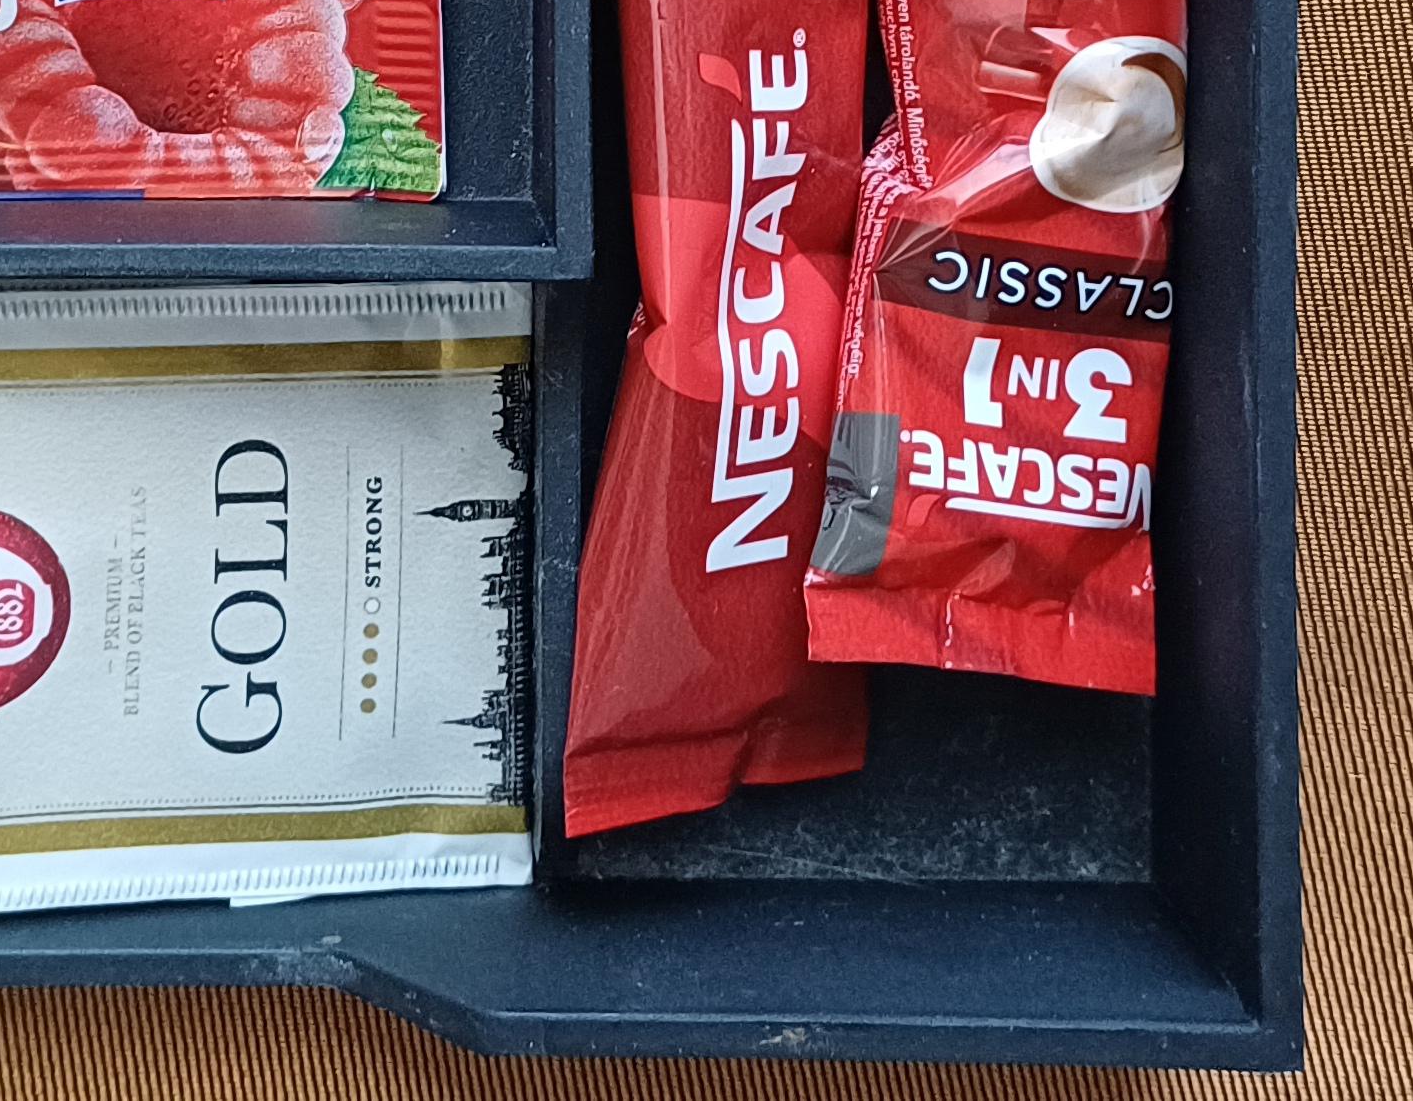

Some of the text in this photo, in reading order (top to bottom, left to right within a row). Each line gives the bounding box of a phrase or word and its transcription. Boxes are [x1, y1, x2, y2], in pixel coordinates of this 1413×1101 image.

[927, 250, 1174, 320] CLASSIC
[364, 475, 383, 588] STRONG
[103, 556, 124, 652] PREMIUM
[126, 619, 144, 646] OF
[196, 438, 289, 755] GOLD
[123, 650, 142, 717] BLEND
